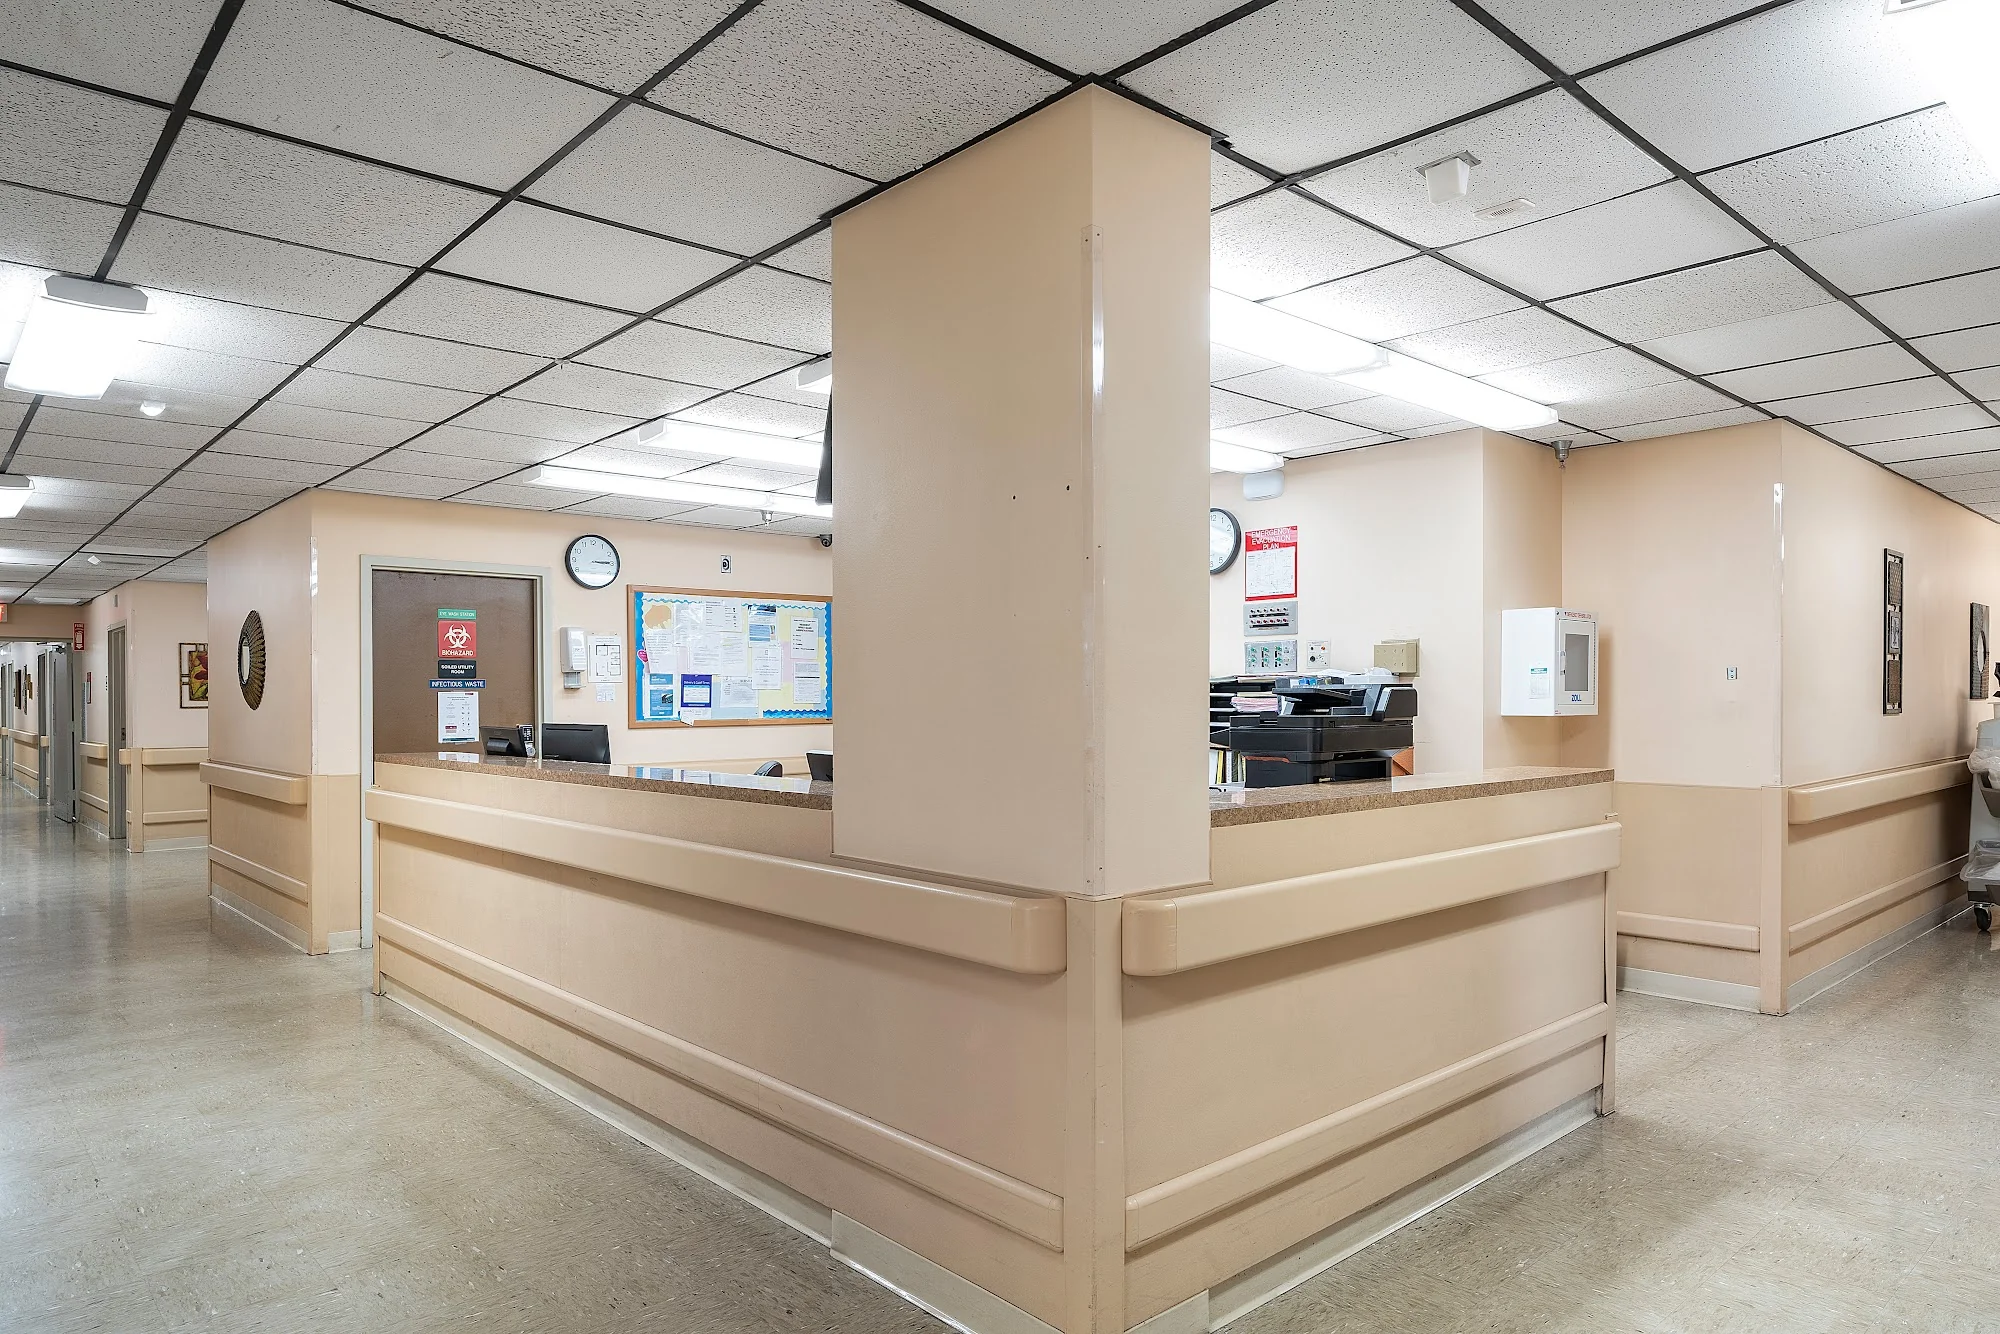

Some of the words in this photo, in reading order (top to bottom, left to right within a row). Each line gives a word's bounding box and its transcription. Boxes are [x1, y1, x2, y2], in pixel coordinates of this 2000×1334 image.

[1251, 527, 1291, 538] EMERGENCY
[1251, 534, 1291, 546] EVACUATION
[1218, 556, 1224, 564] 5
